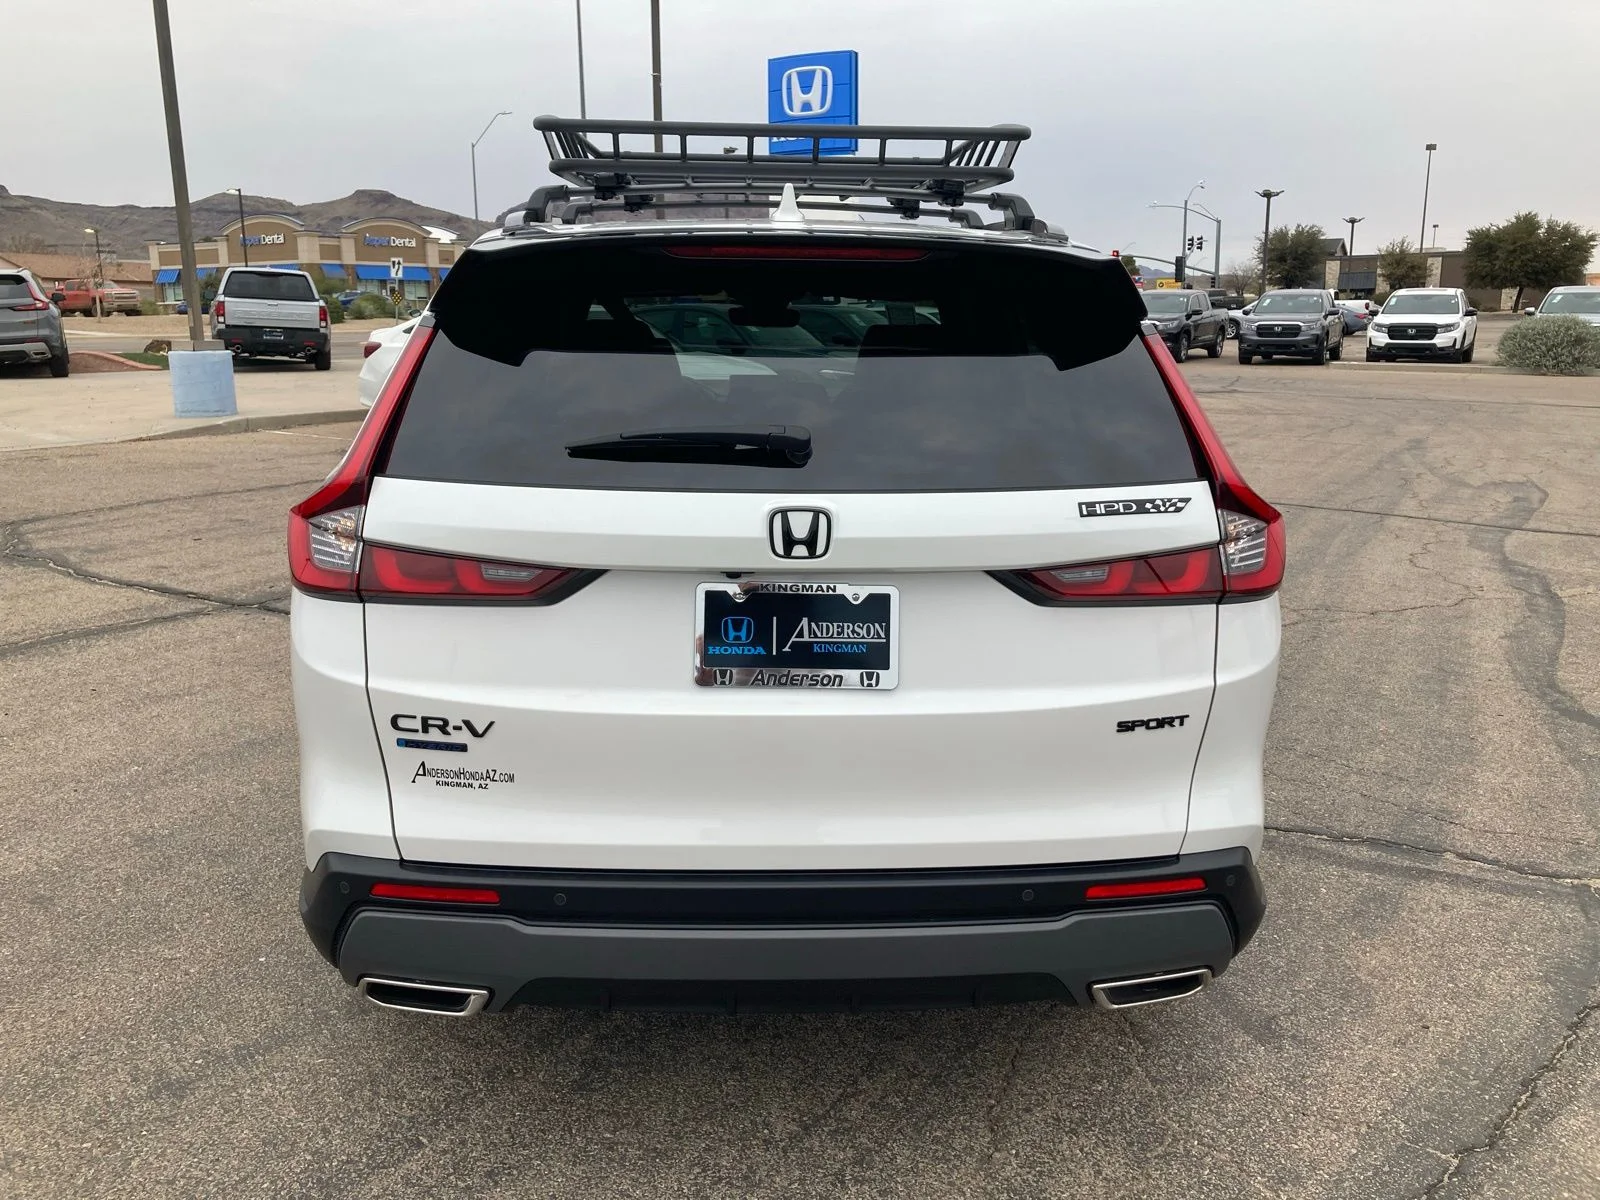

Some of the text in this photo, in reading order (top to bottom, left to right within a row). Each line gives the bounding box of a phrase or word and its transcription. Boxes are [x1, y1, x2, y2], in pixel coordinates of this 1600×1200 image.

[261, 233, 285, 245] Dental
[390, 236, 417, 248] Dental
[1081, 502, 1137, 515] HPD
[759, 583, 837, 593] KINGMAN
[782, 617, 887, 652] ANDERSON
[707, 646, 766, 655] HONDA
[813, 643, 867, 653] KINGMAN
[751, 669, 844, 688] Anderson
[390, 713, 496, 738] CR-V
[1116, 714, 1190, 733] SPORT
[435, 779, 476, 790] KINGMAN,
